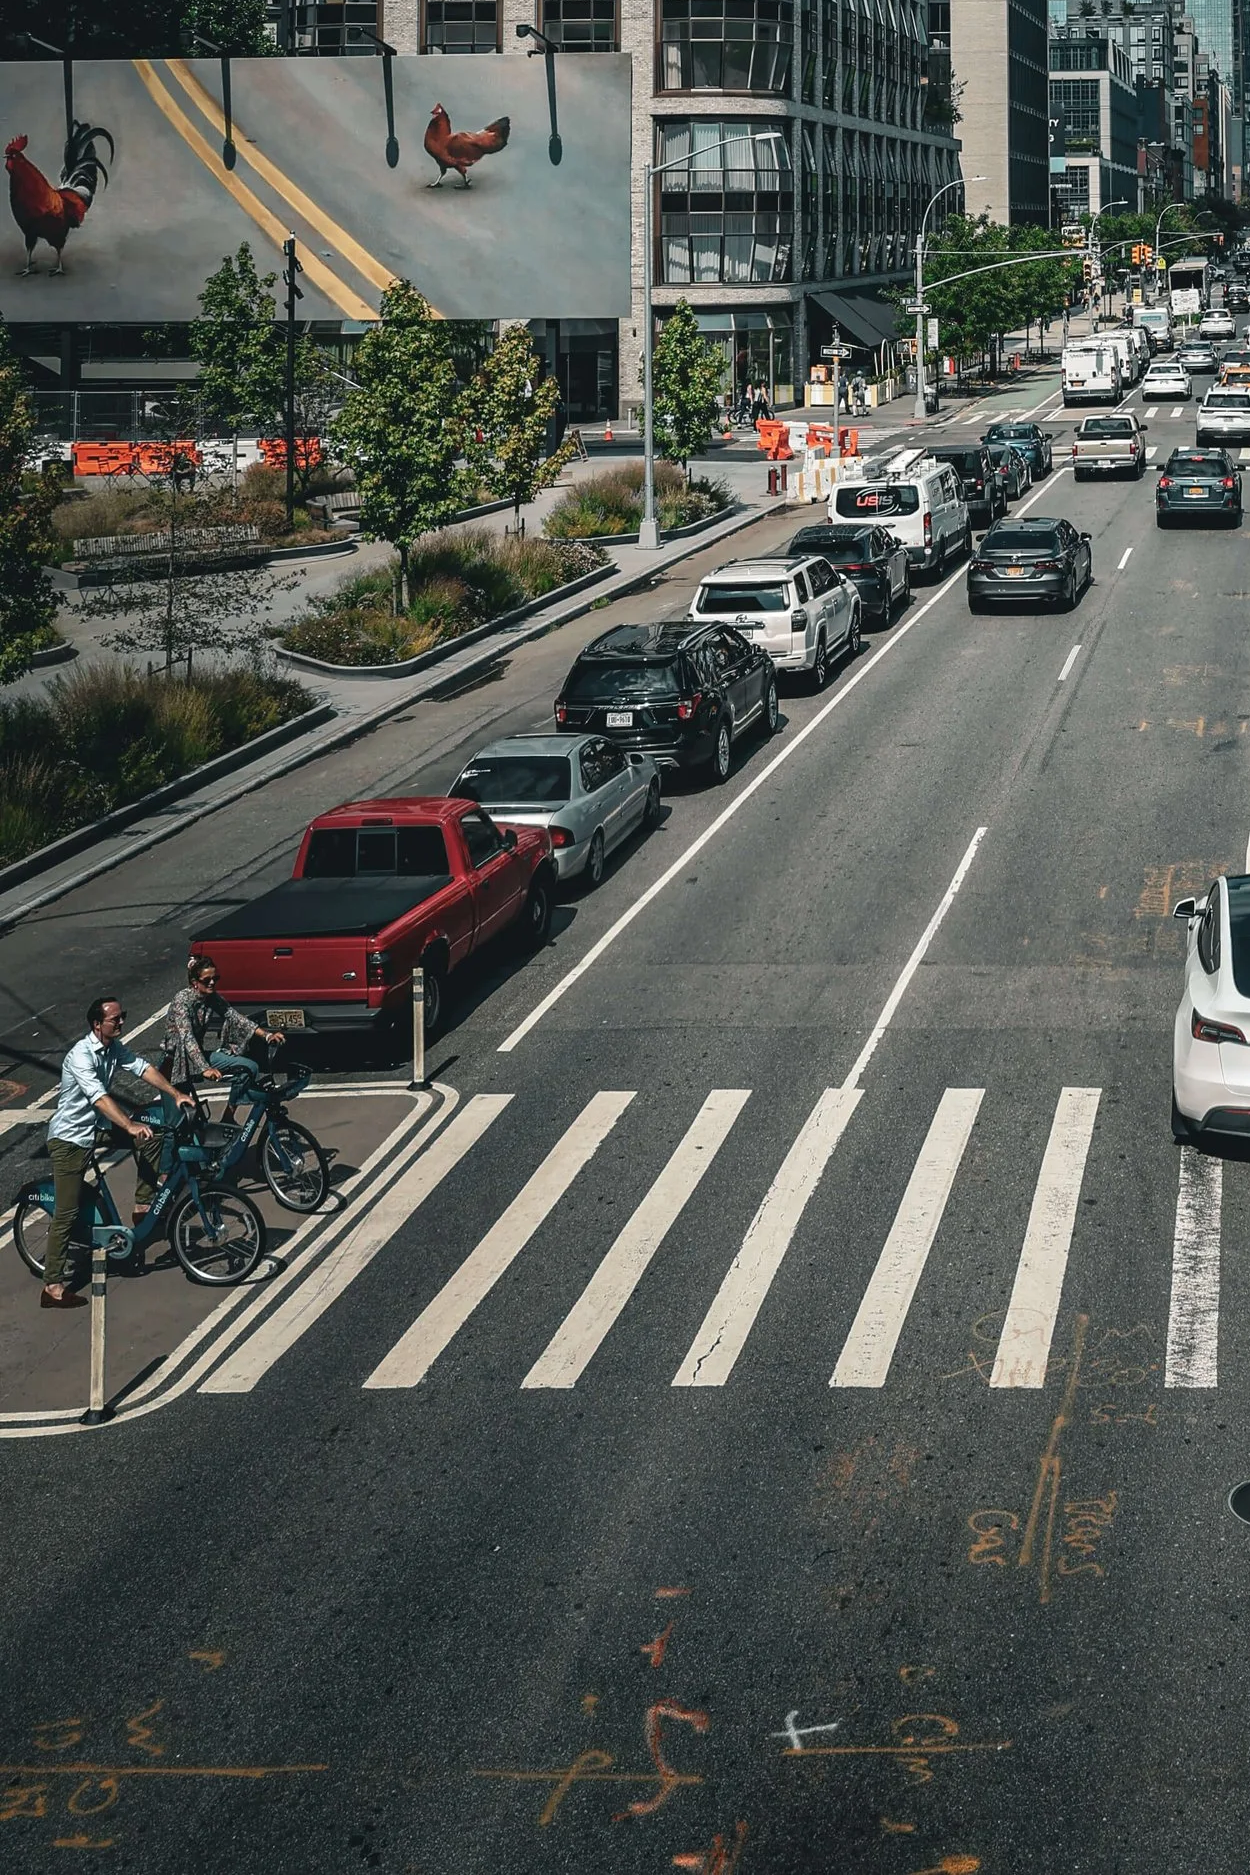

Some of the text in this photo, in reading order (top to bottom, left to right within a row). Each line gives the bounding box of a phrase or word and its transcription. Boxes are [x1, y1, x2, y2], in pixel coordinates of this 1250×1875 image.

[856, 495, 893, 507] USIS
[140, 1115, 161, 1125] citi bike
[240, 1119, 256, 1142] citi bike
[28, 1193, 55, 1202] citi bike
[153, 1188, 171, 1215] citi bike
